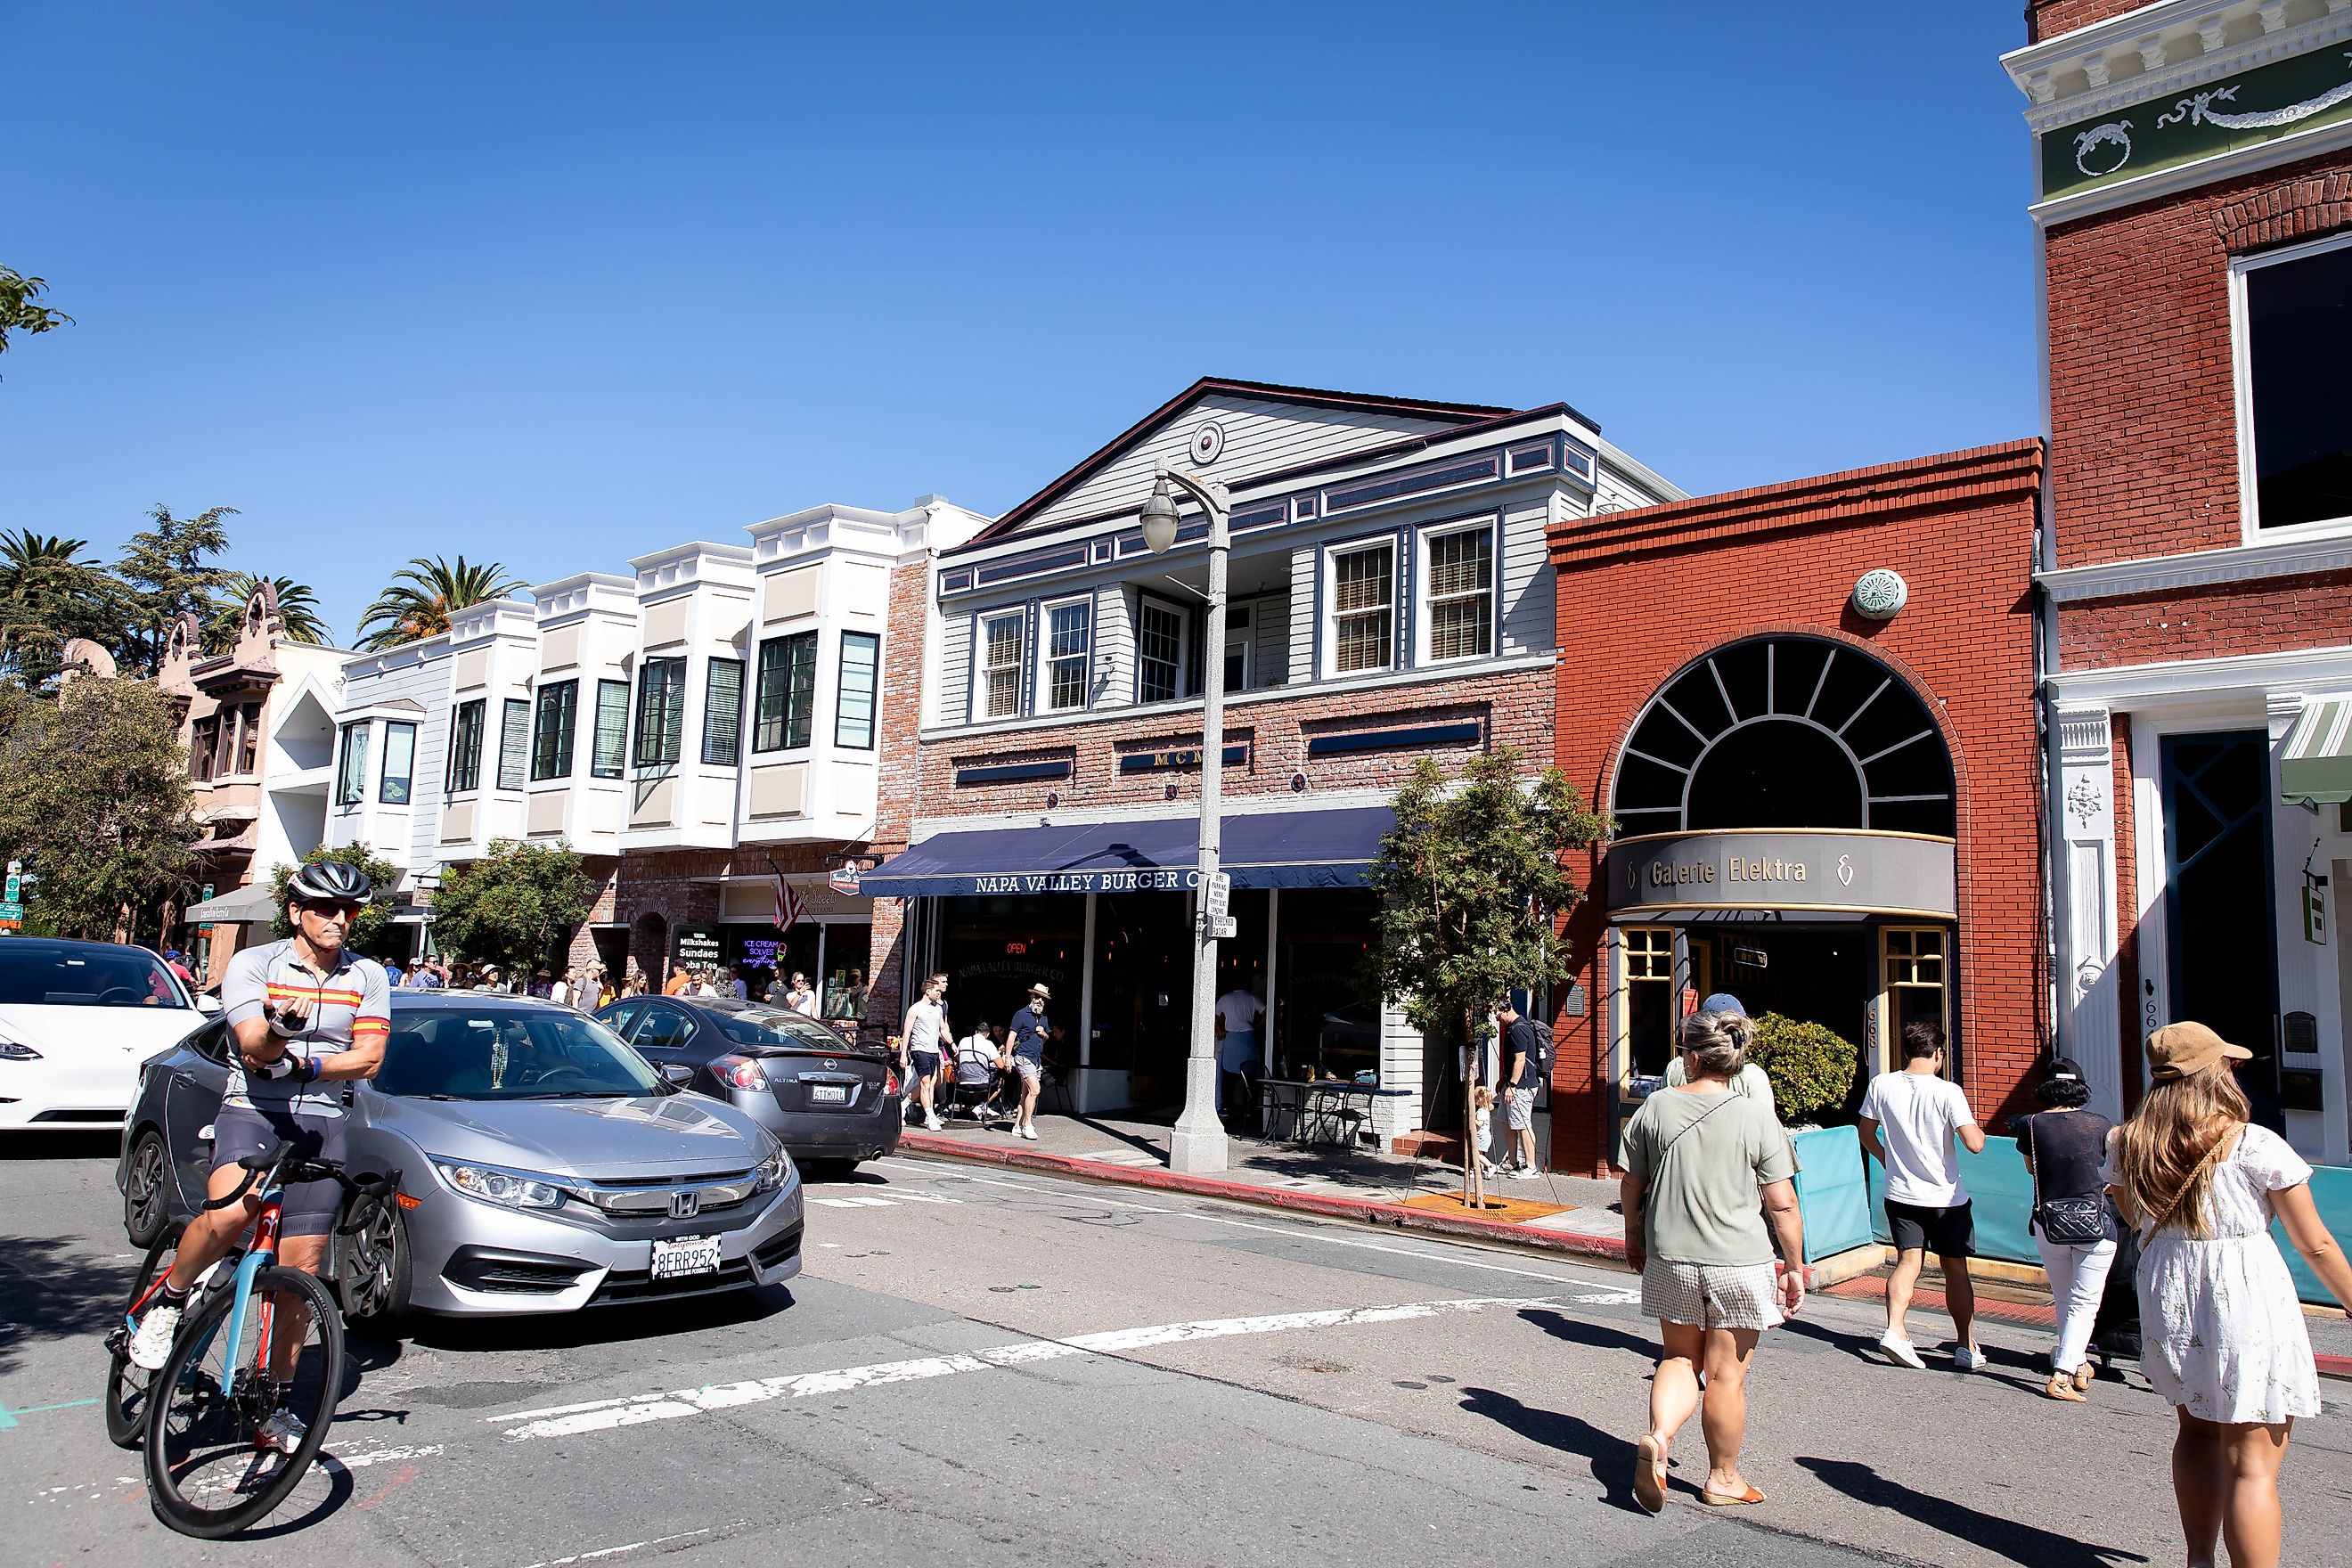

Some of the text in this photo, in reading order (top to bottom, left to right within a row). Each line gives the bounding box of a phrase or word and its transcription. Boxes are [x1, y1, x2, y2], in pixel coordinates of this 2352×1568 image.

[1651, 856, 1807, 886] Galerie Elektra
[976, 877, 1019, 892] NAPA
[1025, 874, 1094, 892] VALLEY
[1100, 871, 1179, 890] BURGER
[680, 938, 719, 947] Milkshakes
[679, 948, 719, 959] Sundaes
[749, 948, 774, 956] SOLVES
[1007, 943, 1026, 954] OPEN
[702, 961, 718, 970] Tea
[1868, 1008, 1877, 1049] 668
[657, 1248, 715, 1271] 8FRR952
